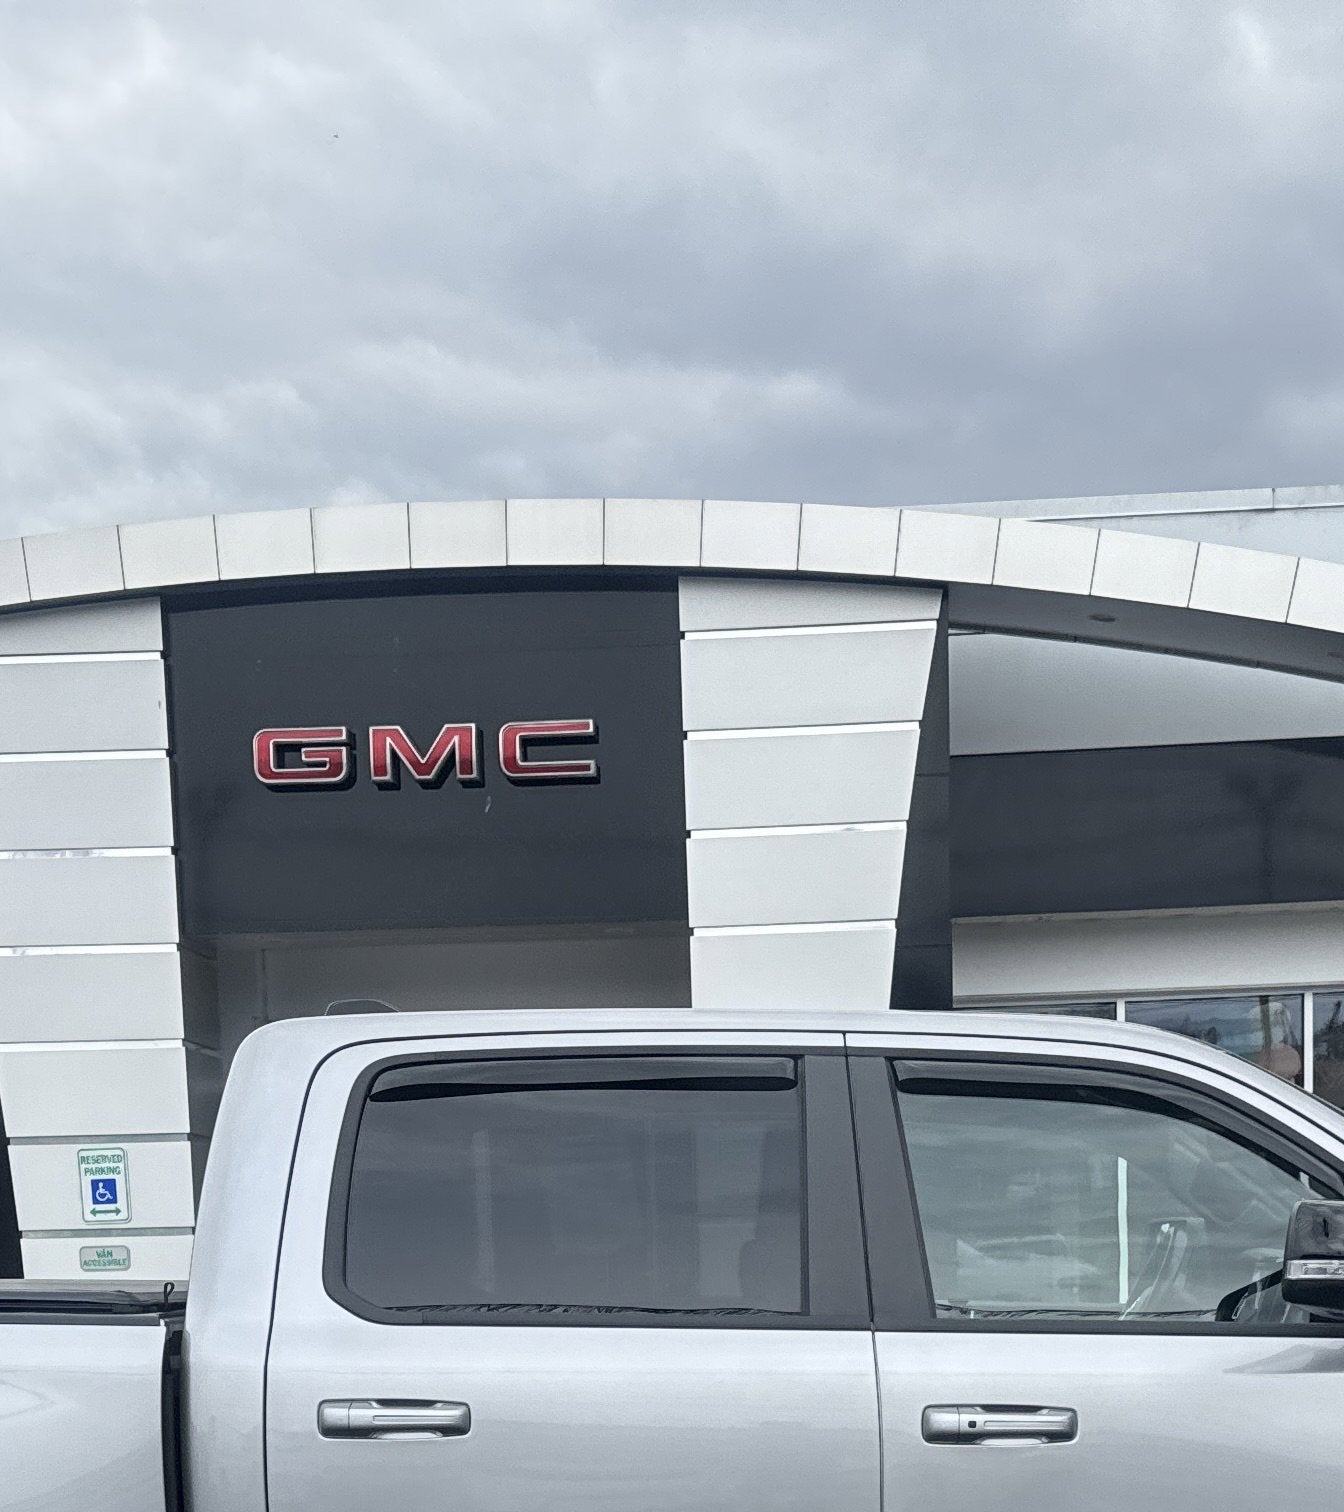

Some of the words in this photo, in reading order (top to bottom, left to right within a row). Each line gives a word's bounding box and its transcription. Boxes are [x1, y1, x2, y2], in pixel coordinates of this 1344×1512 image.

[253, 719, 598, 787] GMC
[80, 1154, 123, 1165] RESERVED
[84, 1166, 121, 1176] PARKING
[96, 1250, 113, 1258] VAN
[83, 1258, 127, 1267] ACCESSIBLE
